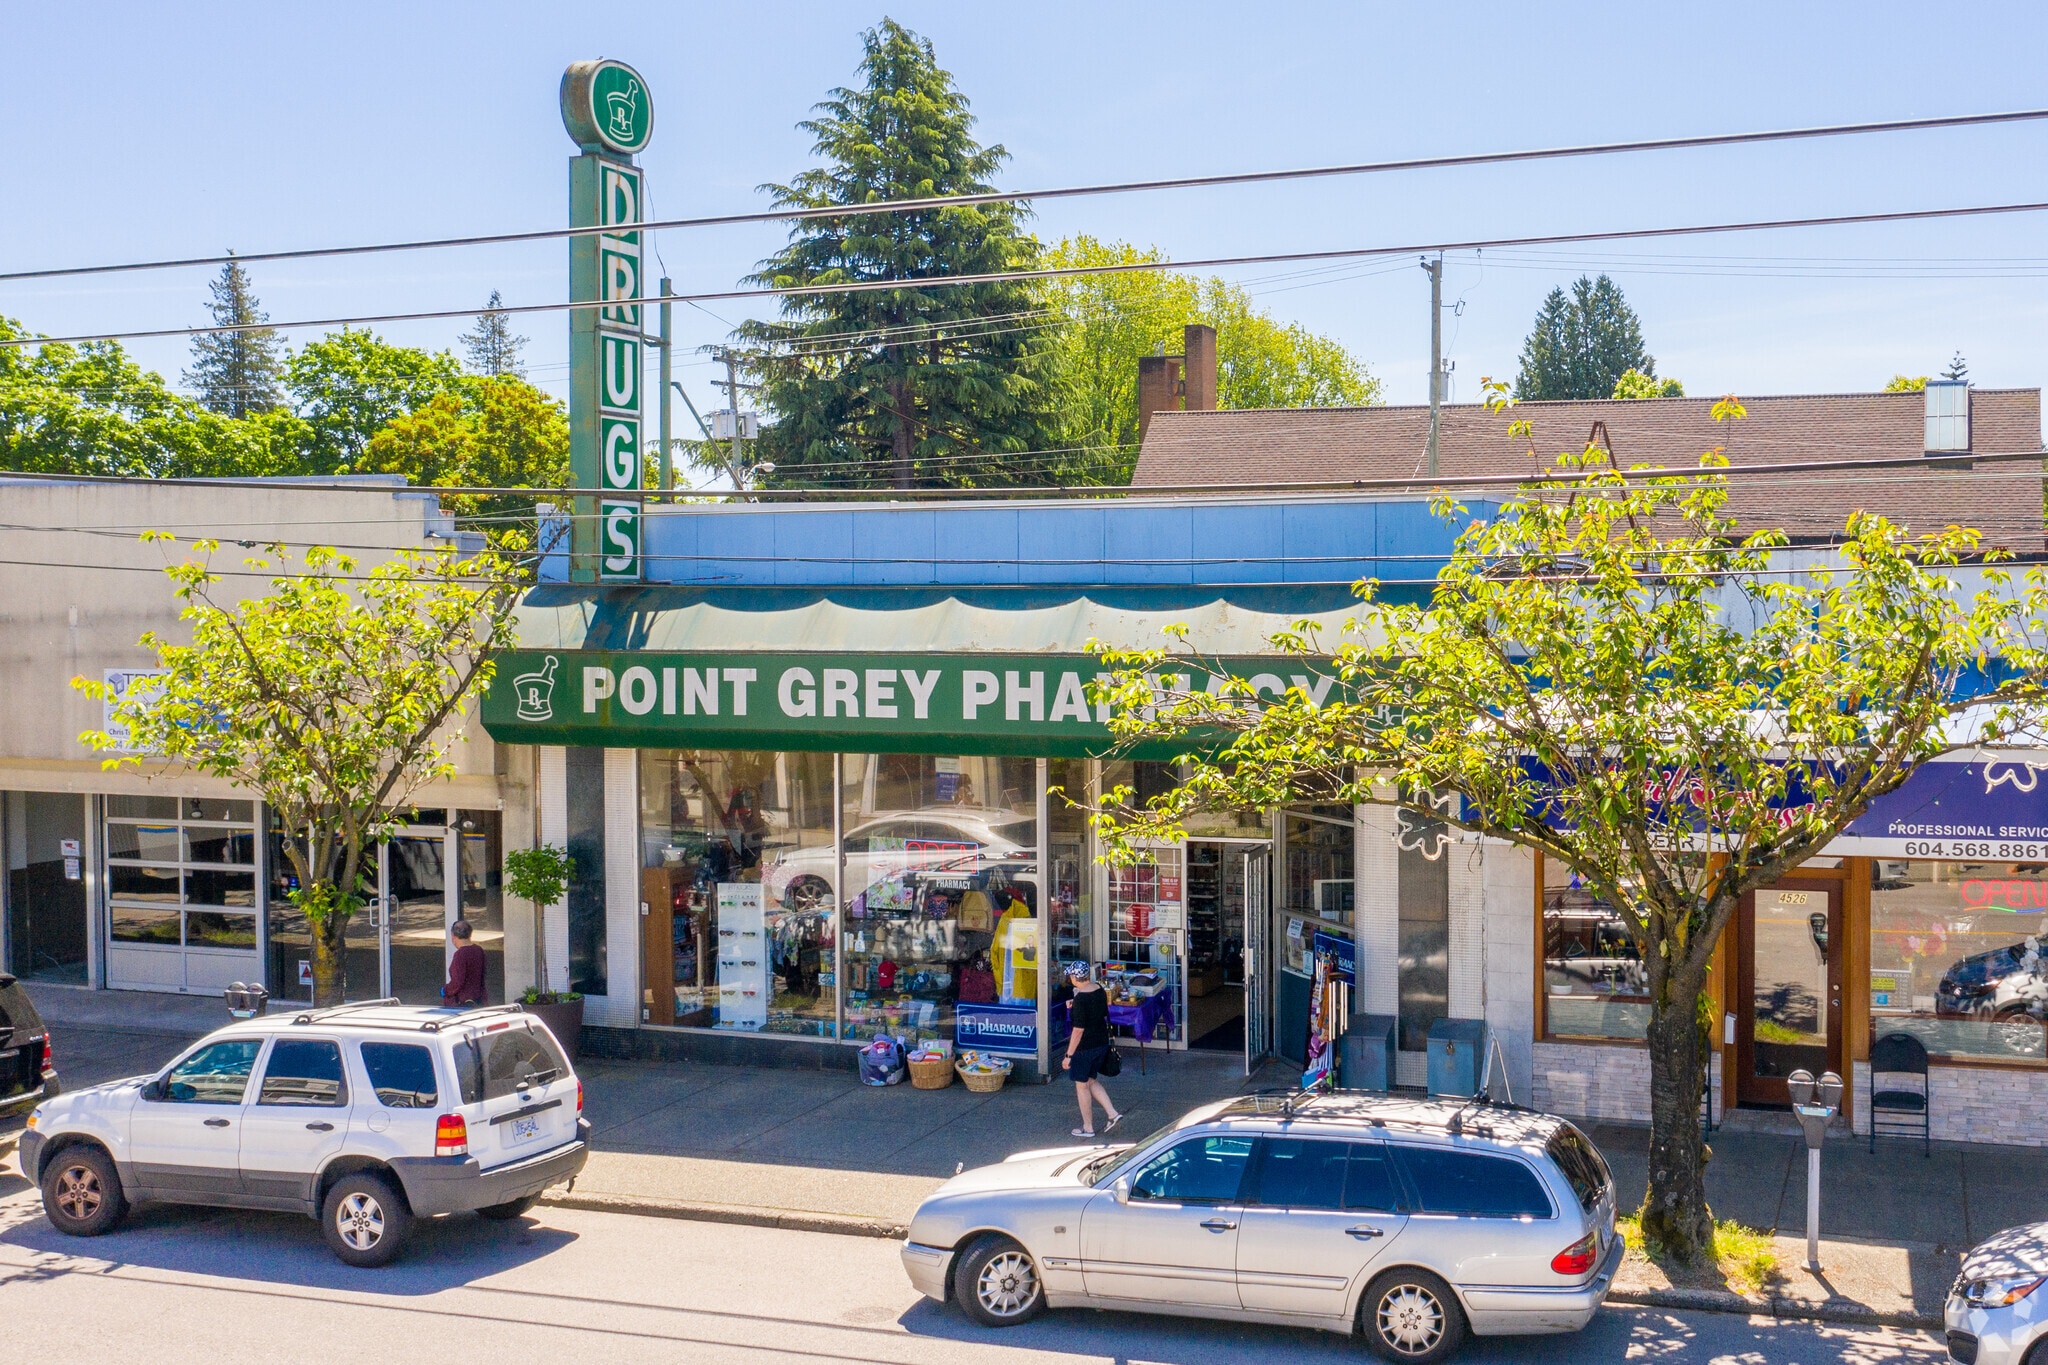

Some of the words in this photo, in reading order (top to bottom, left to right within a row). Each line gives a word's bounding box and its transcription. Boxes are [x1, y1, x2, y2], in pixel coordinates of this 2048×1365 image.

[605, 170, 636, 572] DRUGS
[583, 665, 757, 716] POINT
[777, 667, 942, 719] GREY
[1888, 823, 1995, 837] PROFESSIONAL
[906, 841, 977, 874] OPEN
[1905, 841, 2048, 858] 604.568.8861
[936, 878, 971, 891] PHARMACY
[1961, 879, 2048, 907] OPEN
[1779, 893, 1807, 904] 4526
